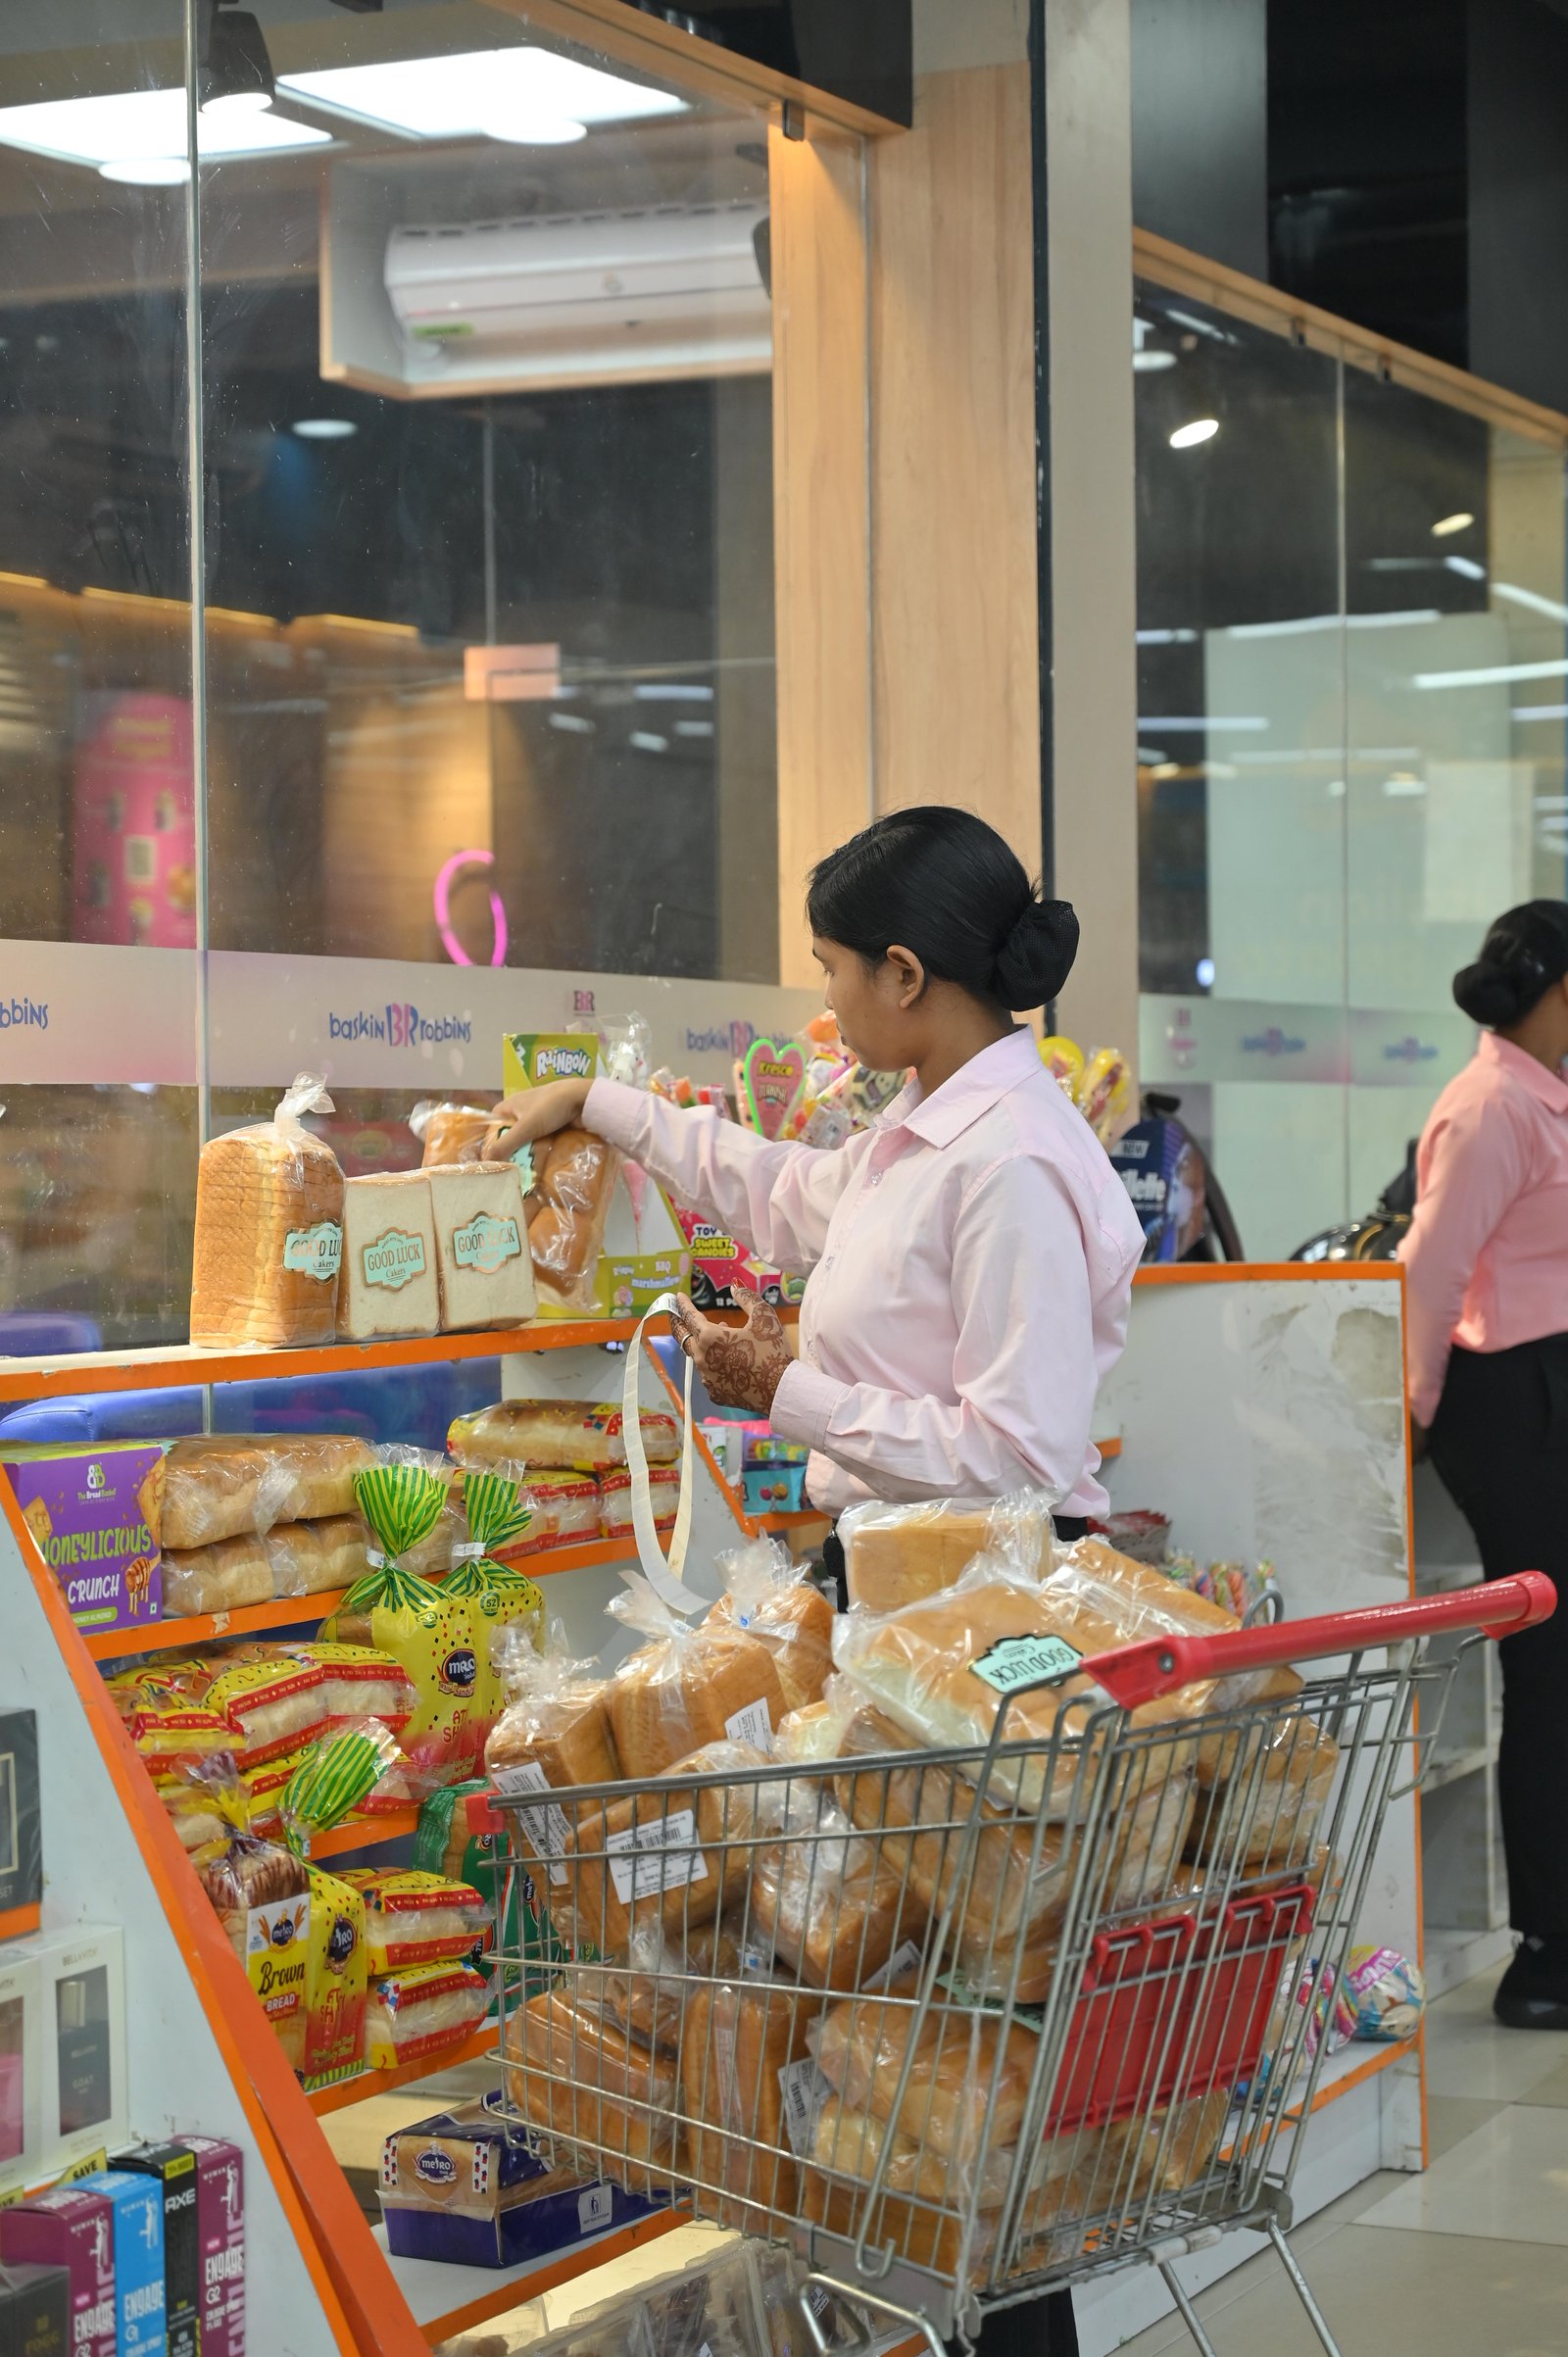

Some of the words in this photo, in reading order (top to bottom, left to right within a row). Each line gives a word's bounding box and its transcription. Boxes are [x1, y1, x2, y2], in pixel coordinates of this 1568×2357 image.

[420, 1016, 471, 1043] robbins
[696, 1226, 717, 1236] TOY
[458, 1233, 486, 1253] GOOD
[691, 1247, 735, 1258] CANDIES
[694, 1237, 731, 1250] SWEET
[368, 1250, 395, 1271] GOOD
[396, 1244, 421, 1264] LUCK
[386, 1268, 407, 1278] Cakers
[68, 1573, 121, 1604] CRUNCH
[989, 1659, 1034, 1685] LUCK
[258, 1961, 306, 1995] Brown
[267, 1992, 296, 2013] BREAD
[73, 2159, 98, 2181] SAVE
[165, 2187, 196, 2214] AXE
